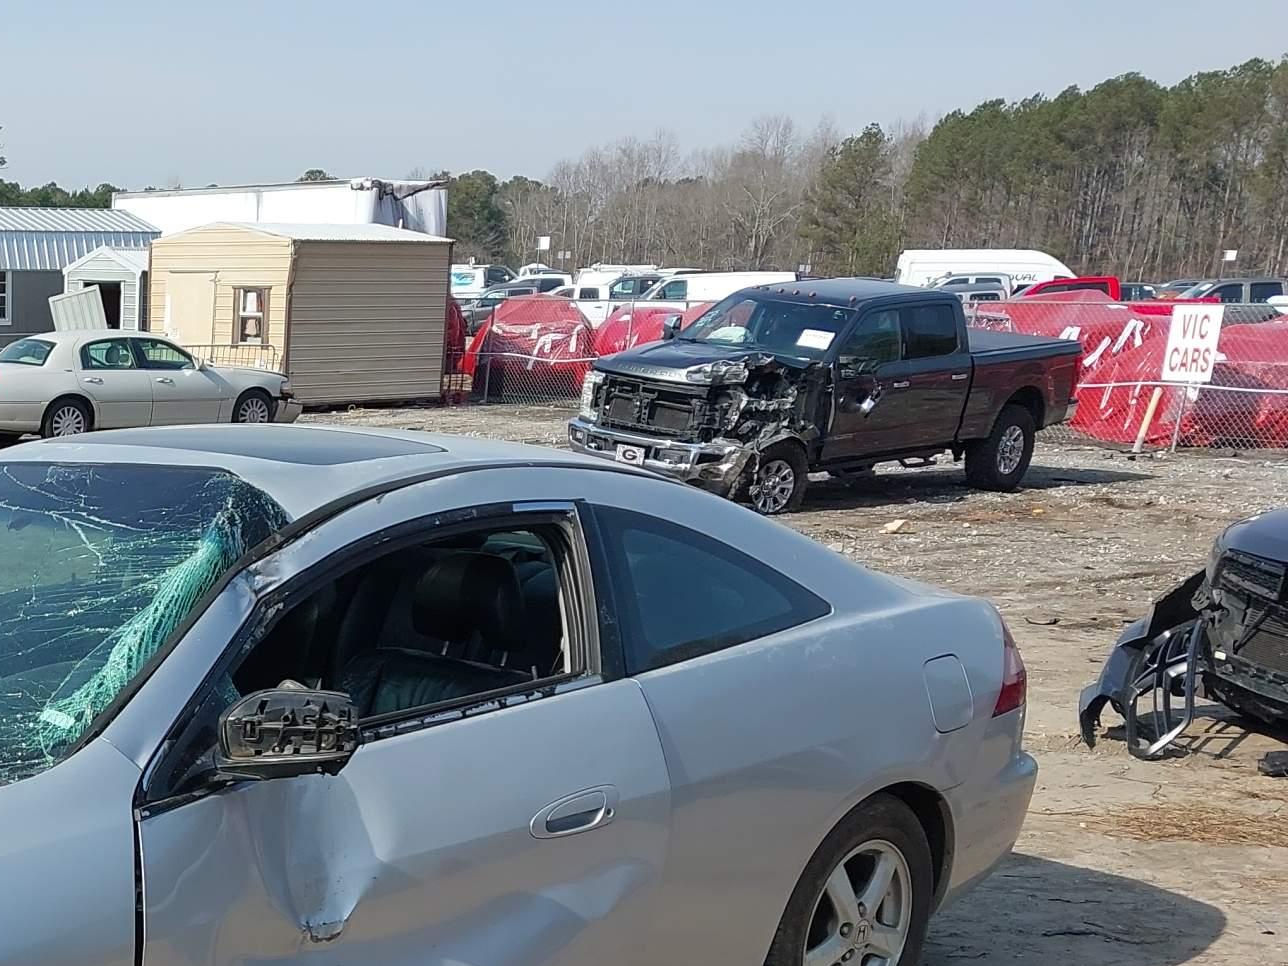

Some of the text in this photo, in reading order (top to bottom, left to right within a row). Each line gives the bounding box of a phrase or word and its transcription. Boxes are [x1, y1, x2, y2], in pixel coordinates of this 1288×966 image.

[1182, 313, 1211, 339] VIC
[1168, 346, 1212, 373] CARS
[622, 449, 638, 461] G
